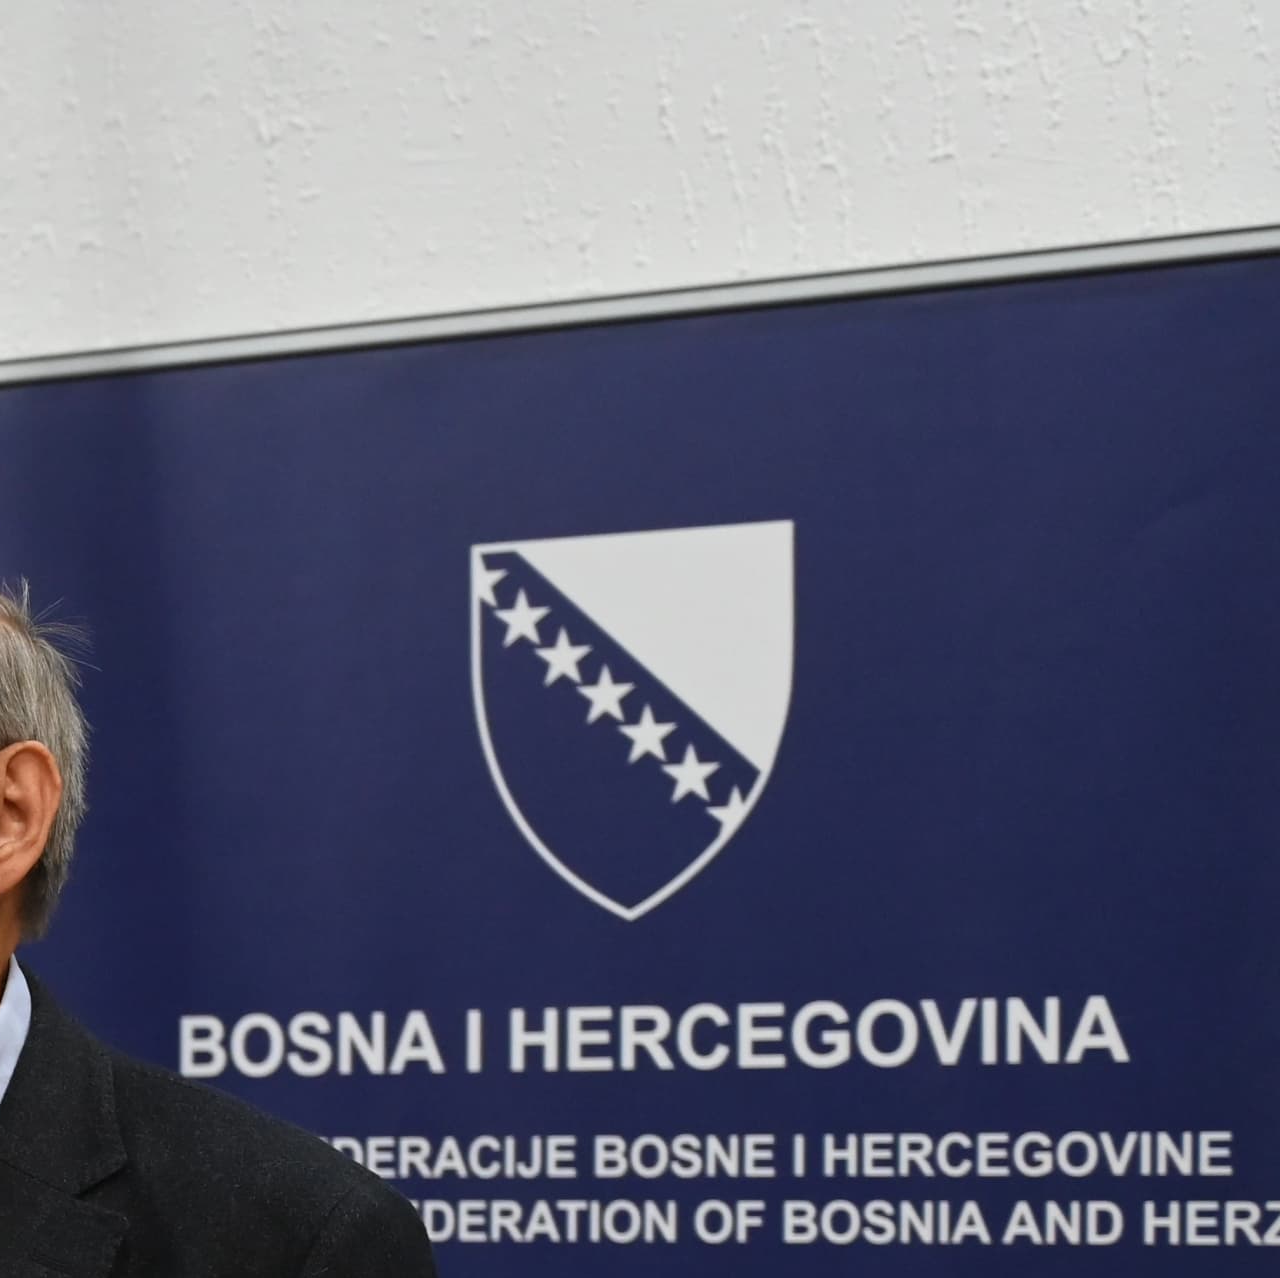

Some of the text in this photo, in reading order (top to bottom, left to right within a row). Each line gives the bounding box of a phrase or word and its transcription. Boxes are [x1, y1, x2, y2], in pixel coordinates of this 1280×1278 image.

[178, 995, 1130, 1078] BOSNA I HERCEGOVINA
[593, 1134, 775, 1177] BOSNE
[793, 1133, 805, 1176] I
[822, 1130, 1233, 1177] HERCEGOVINE
[408, 1199, 675, 1243] DERATION
[693, 1200, 762, 1243] OF
[782, 1200, 992, 1245] BOSNIA
[1002, 1200, 1124, 1245] AND
